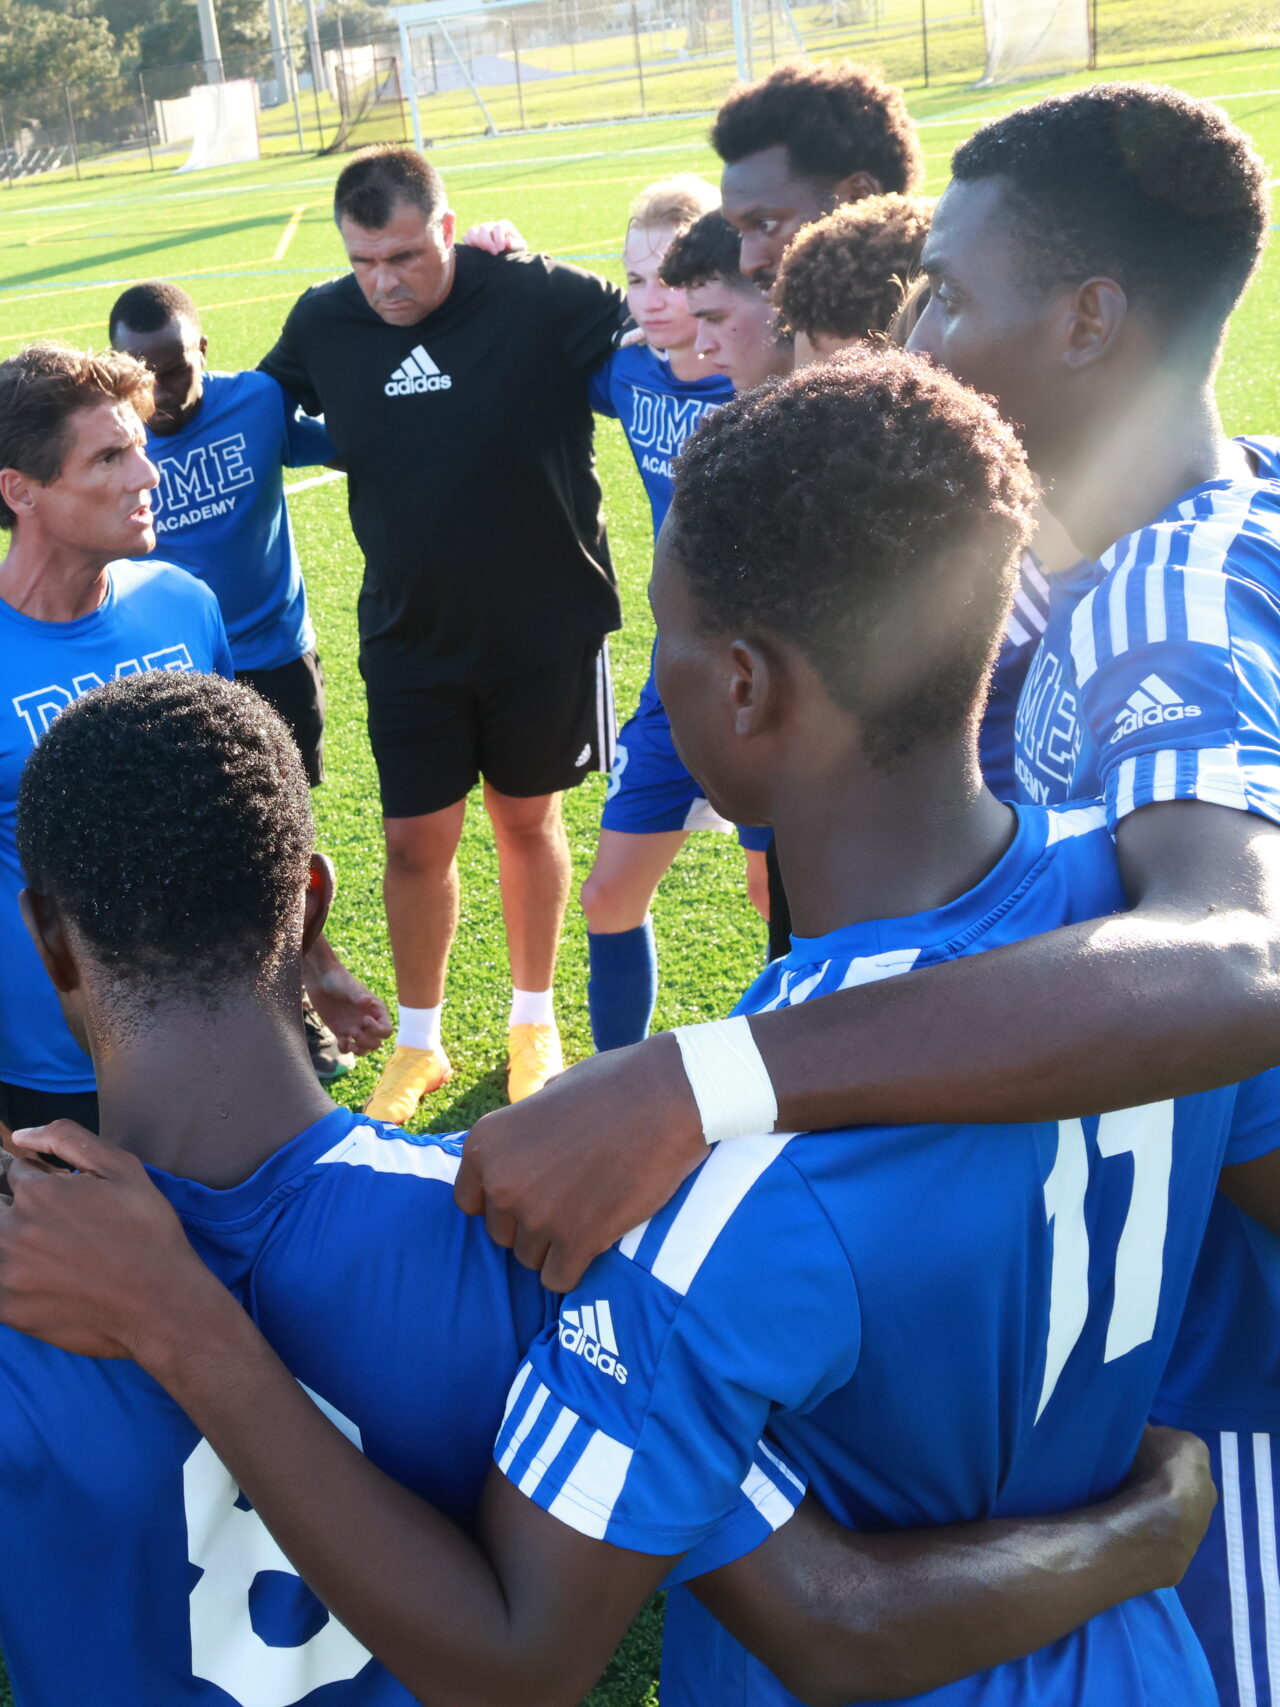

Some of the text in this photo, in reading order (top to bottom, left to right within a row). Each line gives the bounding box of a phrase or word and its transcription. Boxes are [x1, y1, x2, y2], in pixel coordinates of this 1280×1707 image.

[384, 374, 452, 396] adidas
[155, 496, 237, 534] ACADEMY
[1109, 704, 1203, 745] adidas
